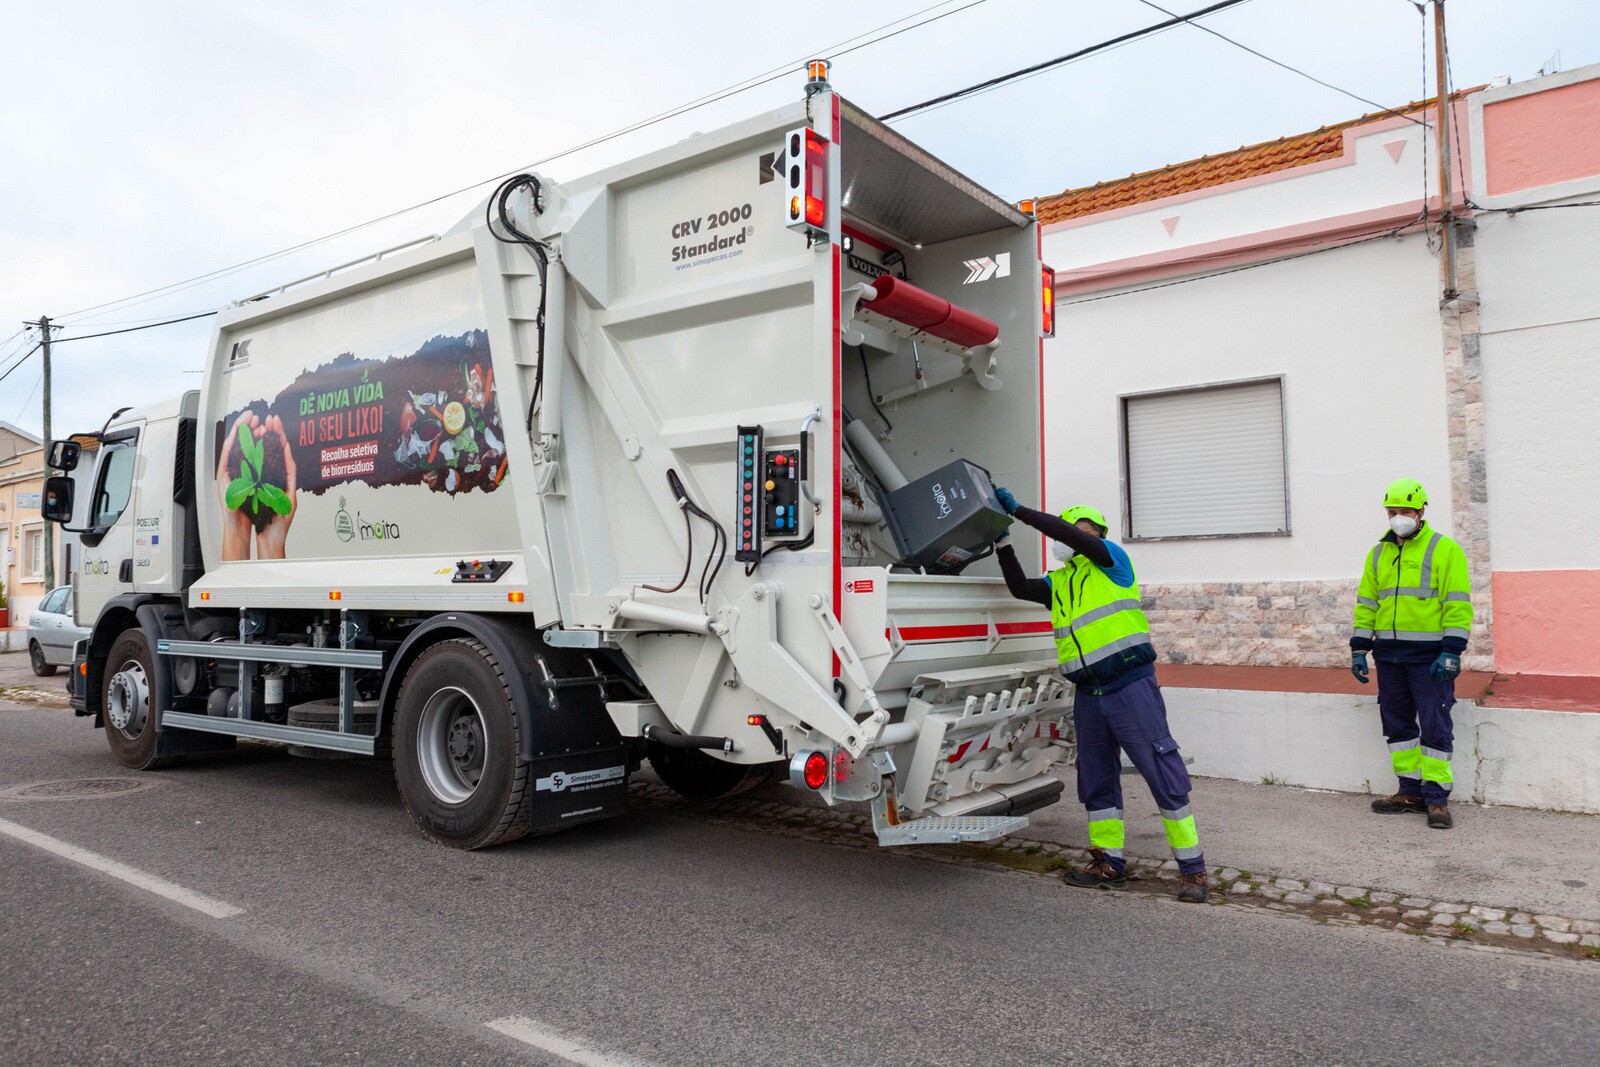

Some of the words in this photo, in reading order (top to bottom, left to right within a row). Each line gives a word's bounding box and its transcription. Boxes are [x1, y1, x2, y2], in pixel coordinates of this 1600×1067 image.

[671, 217, 702, 239] CRV
[707, 203, 752, 231] 2000
[676, 249, 743, 271] www.simopecas.com
[299, 392, 315, 417] DÊ
[317, 388, 350, 413] NOVA
[353, 381, 384, 405] VIDA
[299, 418, 315, 446] AO
[319, 412, 343, 443] SEU
[347, 404, 383, 438] LIXO!
[321, 447, 348, 462] Recolha
[349, 442, 378, 457] seletiva
[321, 465, 331, 477] de
[331, 460, 374, 476] biorresíduos
[360, 519, 400, 541] moita
